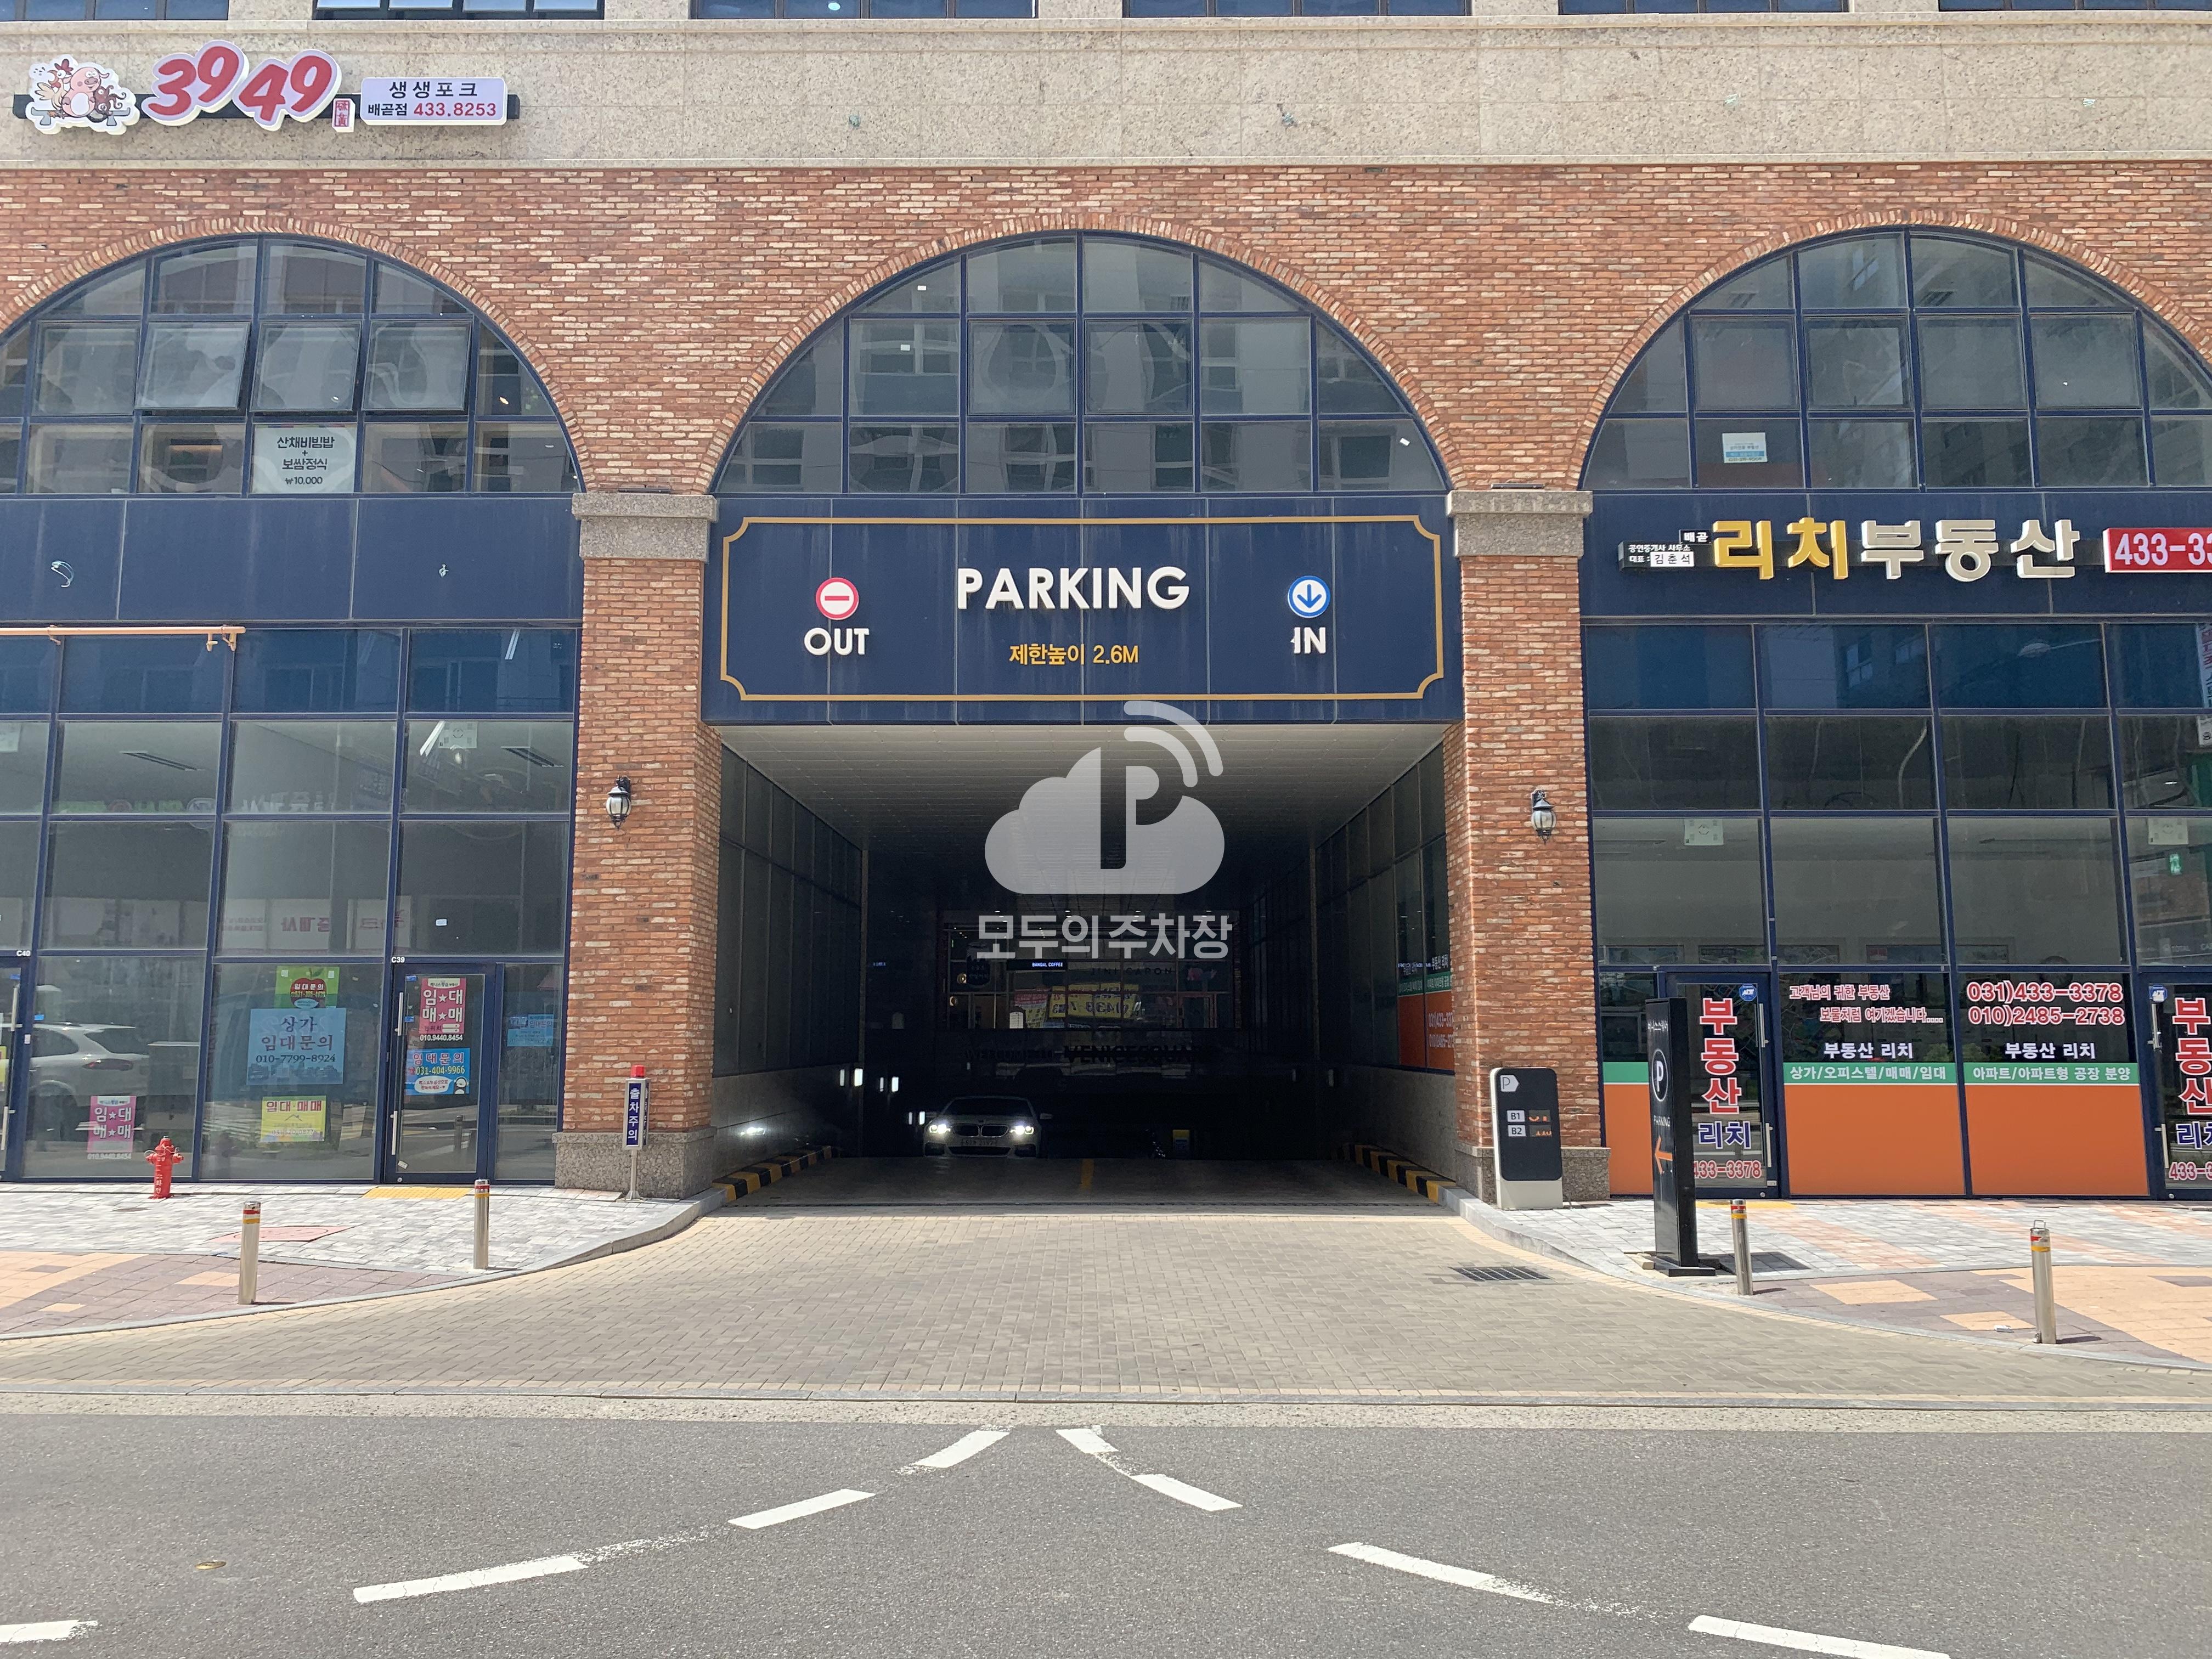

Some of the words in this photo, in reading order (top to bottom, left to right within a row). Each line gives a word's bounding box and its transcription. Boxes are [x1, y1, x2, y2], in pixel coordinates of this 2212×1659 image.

[147, 44, 333, 122] 3949
[389, 82, 478, 98] 생생포크
[368, 103, 407, 117] 배곧점
[413, 103, 497, 117] 433.8253
[276, 437, 335, 449] 산채비빔밥
[282, 458, 328, 470] 보쌈정식
[1684, 532, 1708, 542] 배곧
[1629, 544, 1667, 553] 공인중개사
[1712, 517, 2080, 581] 리치부동산
[1655, 554, 1690, 565] 김춘석
[957, 566, 1191, 610] PARKING
[803, 627, 870, 656] OUT
[1293, 627, 1328, 655] IN
[1008, 644, 1086, 665] 제한높이
[1093, 646, 1140, 664] 2.6M
[1790, 984, 1831, 1001] 고객님의
[1833, 984, 1855, 1001] 귀한
[1858, 984, 1891, 1001] 부동산
[1967, 981, 2124, 1005] 031)433-3378
[1820, 1007, 1861, 1023] 보물처럼
[1968, 1006, 2125, 1027] 010)2485-2738
[280, 1016, 317, 1032] 상가
[261, 1035, 332, 1051] 임대문의
[1824, 1042, 1874, 1059] 부동산
[1881, 1042, 1914, 1059] 리치
[2005, 1043, 2056, 1059] 부동산
[2063, 1043, 2096, 1059] 리치
[256, 1054, 336, 1063] 010-7799-8924
[413, 1052, 465, 1065] 임대문의
[1700, 998, 1742, 1115] 부동산
[416, 1065, 465, 1076] 031-404-9966
[1790, 1066, 1946, 1080] 상가/오피스텔/매매/임대
[1973, 1066, 2069, 1080] 아파트/아파트형
[2074, 1067, 2100, 1080] 공장
[2105, 1067, 2131, 1081] 분양
[628, 1088, 640, 1141] 출차주의
[1654, 1115, 1671, 1127] PARKING
[1698, 1121, 1752, 1149] 리치
